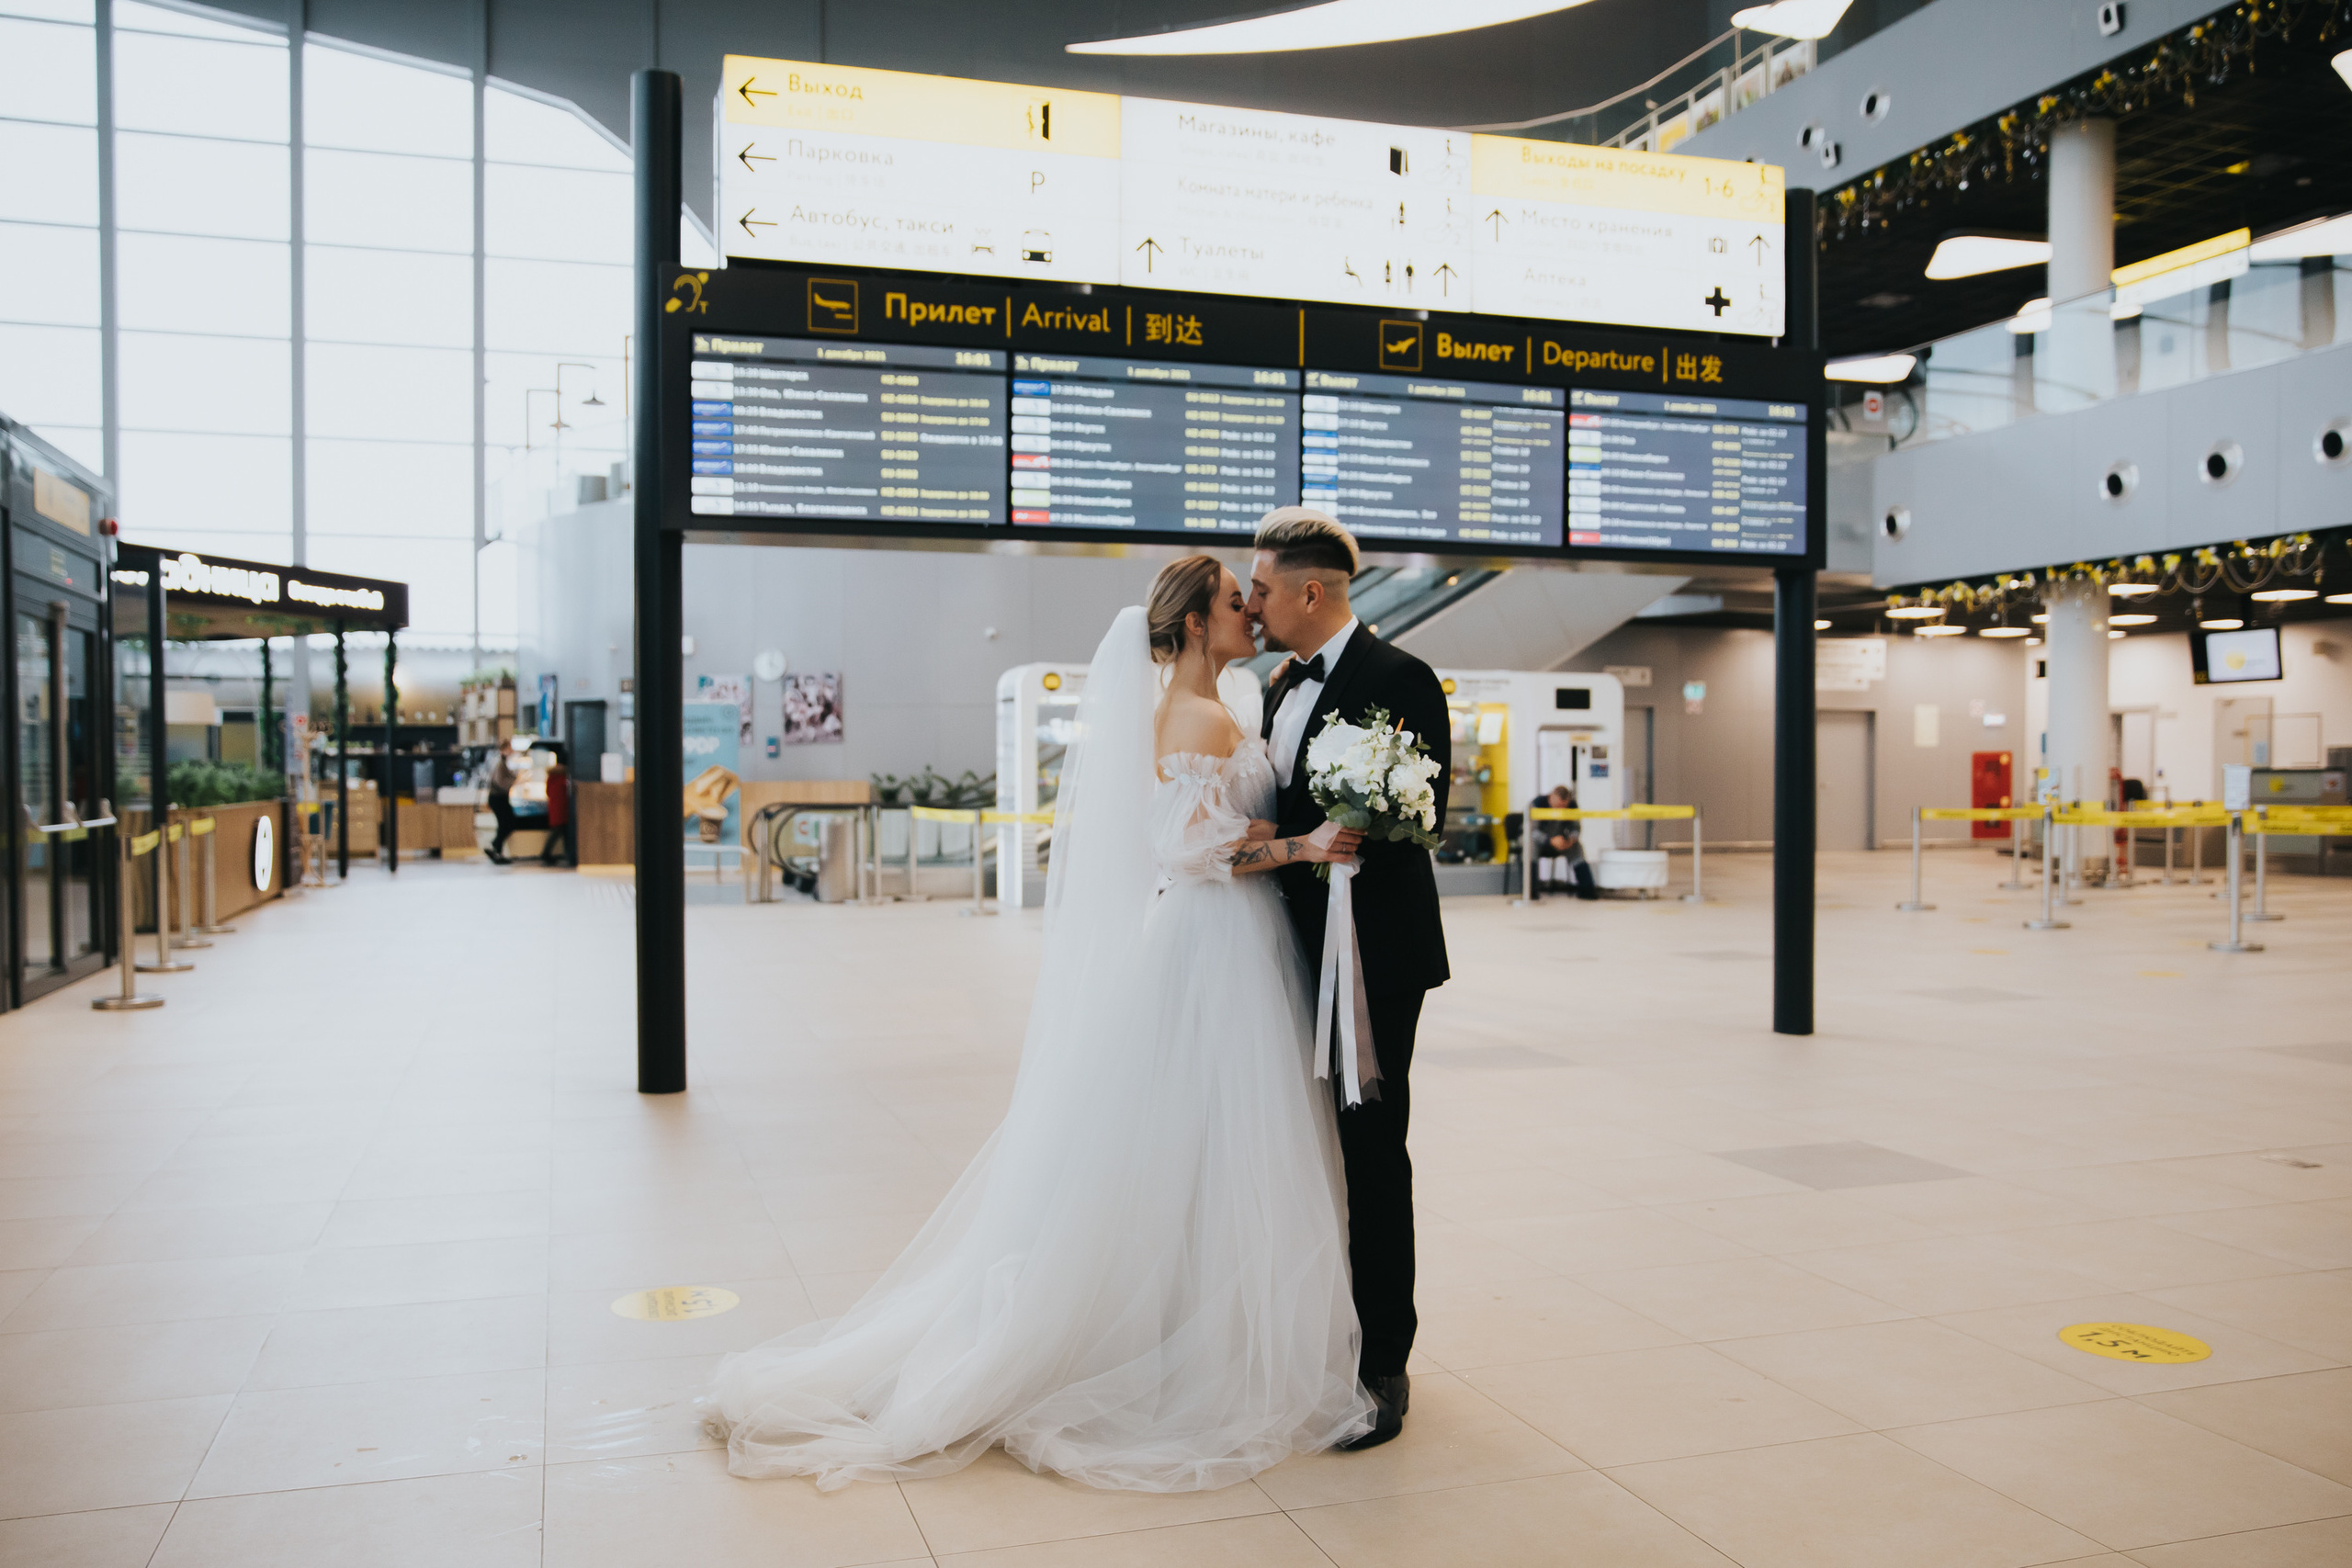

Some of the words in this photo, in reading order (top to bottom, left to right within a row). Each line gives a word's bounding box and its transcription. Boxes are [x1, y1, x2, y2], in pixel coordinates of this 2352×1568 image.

[788, 73, 864, 101] Выход
[1178, 112, 1283, 143] Магазины,
[1289, 128, 1336, 148] кафе
[788, 139, 894, 165] Парковка
[1521, 145, 1591, 169] Выходы
[1595, 159, 1613, 171] на
[1618, 162, 1687, 183] посадку
[1177, 175, 1241, 198] Комната
[1245, 186, 1296, 206] матери
[1302, 193, 1310, 203] и
[1703, 176, 1735, 198] 1-6
[790, 205, 888, 232] Автобус,
[896, 217, 955, 234] такси
[1521, 209, 1581, 230] Место
[1588, 220, 1674, 238] хранения
[1179, 235, 1264, 260] Туалеты
[1523, 266, 1587, 288] Аптека
[885, 292, 997, 327] Прилет
[1021, 301, 1112, 333] Arrival
[1145, 312, 1204, 346] 到达
[1436, 332, 1515, 363] Вылет
[1543, 340, 1655, 373] Departure
[1675, 353, 1724, 384] 出发
